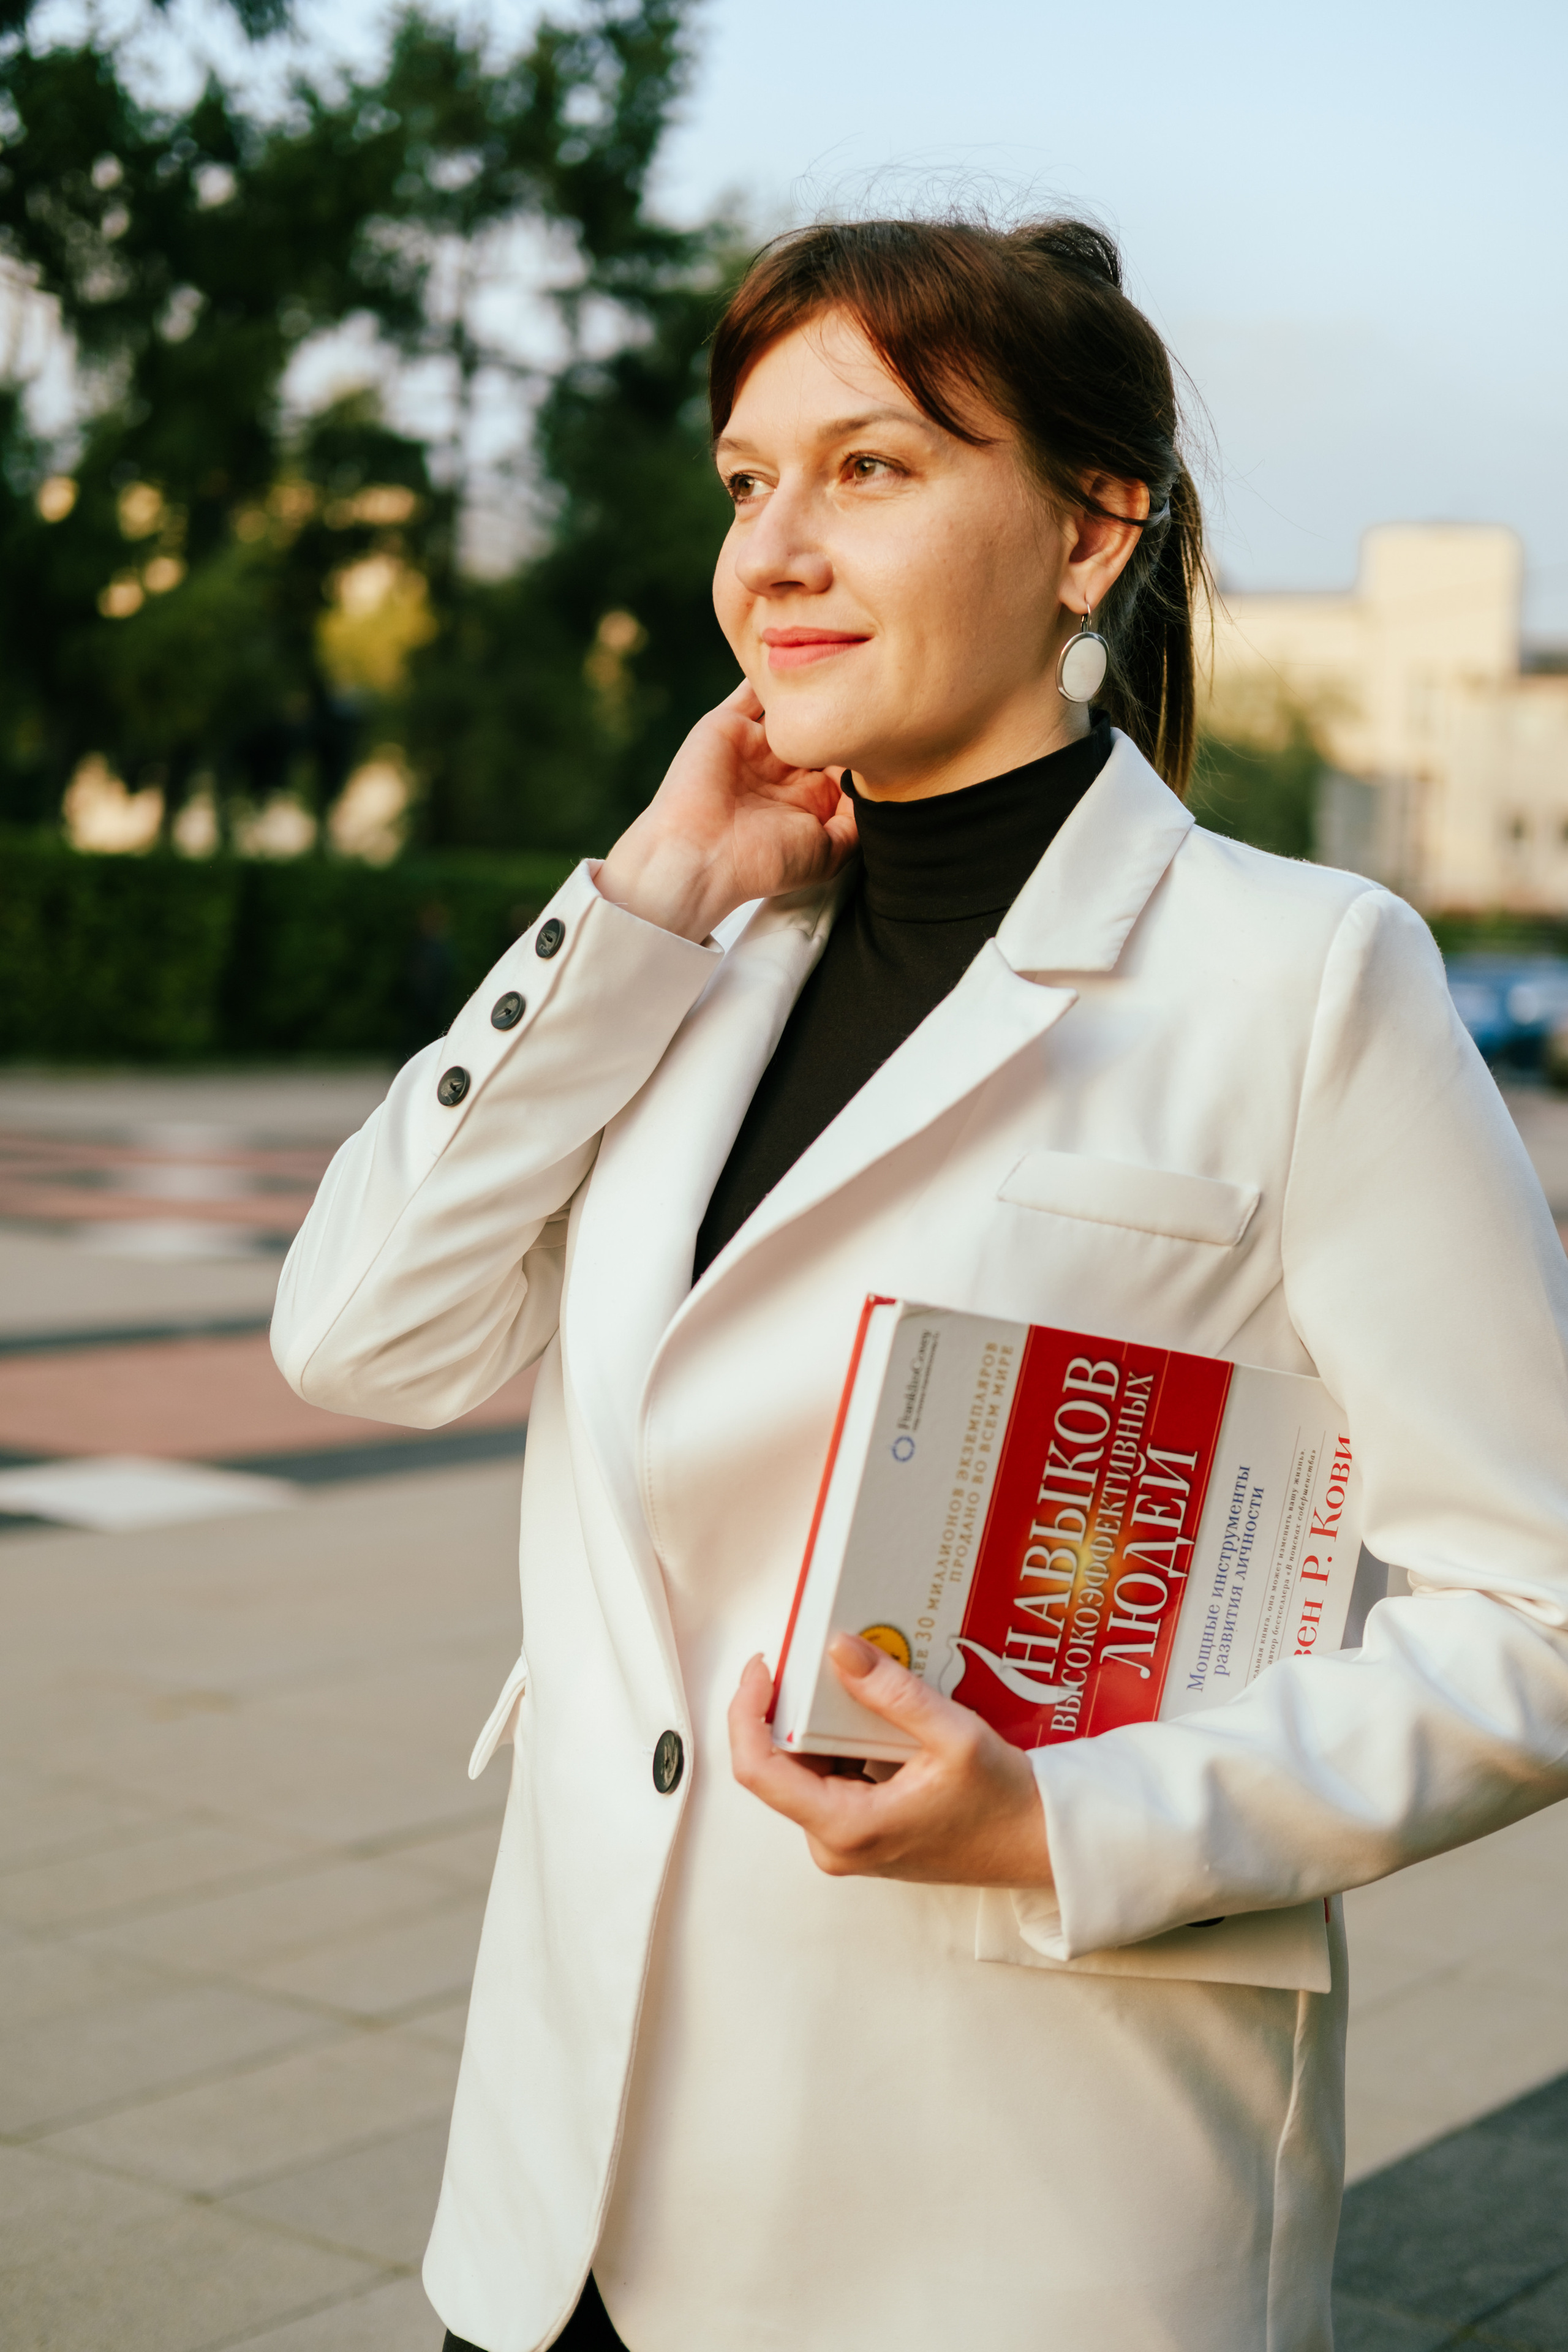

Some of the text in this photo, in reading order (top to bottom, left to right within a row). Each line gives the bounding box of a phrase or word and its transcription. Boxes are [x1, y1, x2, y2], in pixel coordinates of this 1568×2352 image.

[914, 1616, 935, 1642] 30
[927, 1488, 964, 1610] МИЛЛИОНОВ
[956, 1342, 998, 1480] ЭКЗЕМПЛЯРОВ
[938, 1357, 1119, 1703] 7 НАВЫКОВ
[949, 1346, 1013, 1583] ПРОДАНО ВО ВСЕМ МИРЕ
[1050, 1373, 1153, 1733] ВЫСОКОЭФФЕКТИВНЫХ
[1289, 1523, 1301, 1562] поисках
[1298, 1449, 1316, 1521] совершенства»
[1309, 1434, 1352, 1542] Кови
[1100, 1444, 1199, 1679] ЛЮДЕЙ
[1186, 1465, 1250, 1692] Мощные инструменты
[1214, 1486, 1264, 1676] развития личности
[1253, 1648, 1264, 1679] ельная
[1260, 1615, 1272, 1644] книга,
[1271, 1562, 1282, 1591] может
[1278, 1514, 1292, 1559] изменить
[1288, 1488, 1298, 1511] вашу
[1267, 1638, 1279, 1665] автор
[1272, 1579, 1291, 1635] бестселлера
[1300, 1555, 1333, 1586] Р.
